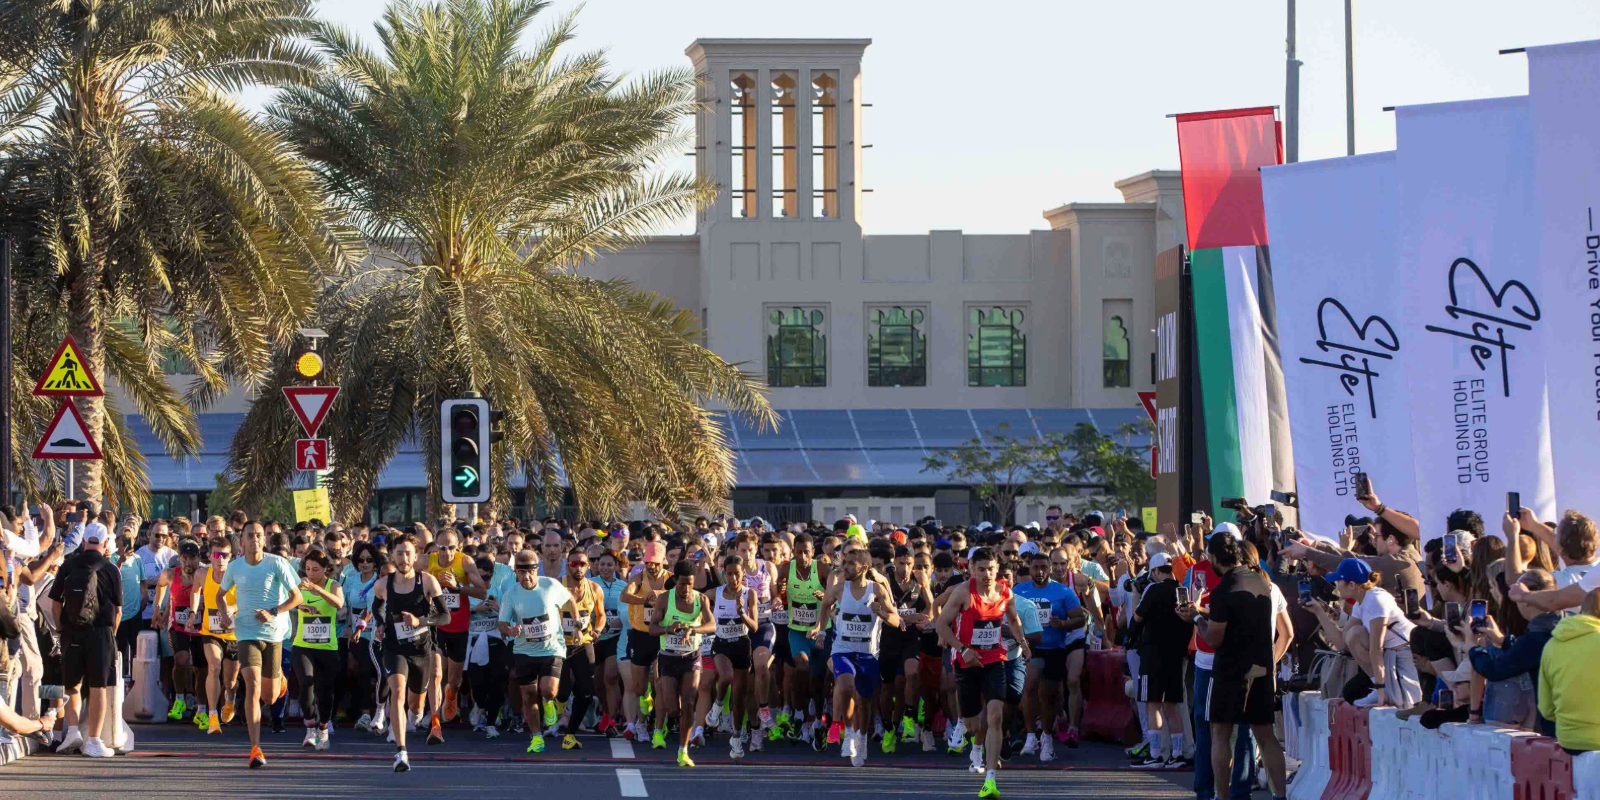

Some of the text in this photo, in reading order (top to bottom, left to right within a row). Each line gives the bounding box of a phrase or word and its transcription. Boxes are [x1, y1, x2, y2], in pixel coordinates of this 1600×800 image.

[1586, 234, 1600, 290] Drive
[1299, 297, 1400, 419] Elite
[1425, 257, 1541, 397] Elite
[1158, 406, 1177, 475] START
[1327, 405, 1348, 496] HOLDING LTD
[1342, 403, 1361, 489] ELITE GROU
[1453, 380, 1472, 484] HOLDING LTD
[1470, 378, 1490, 483] ELITE GROUP
[307, 625, 327, 634] 13010
[795, 609, 815, 618] 13266
[846, 623, 867, 632] 13182
